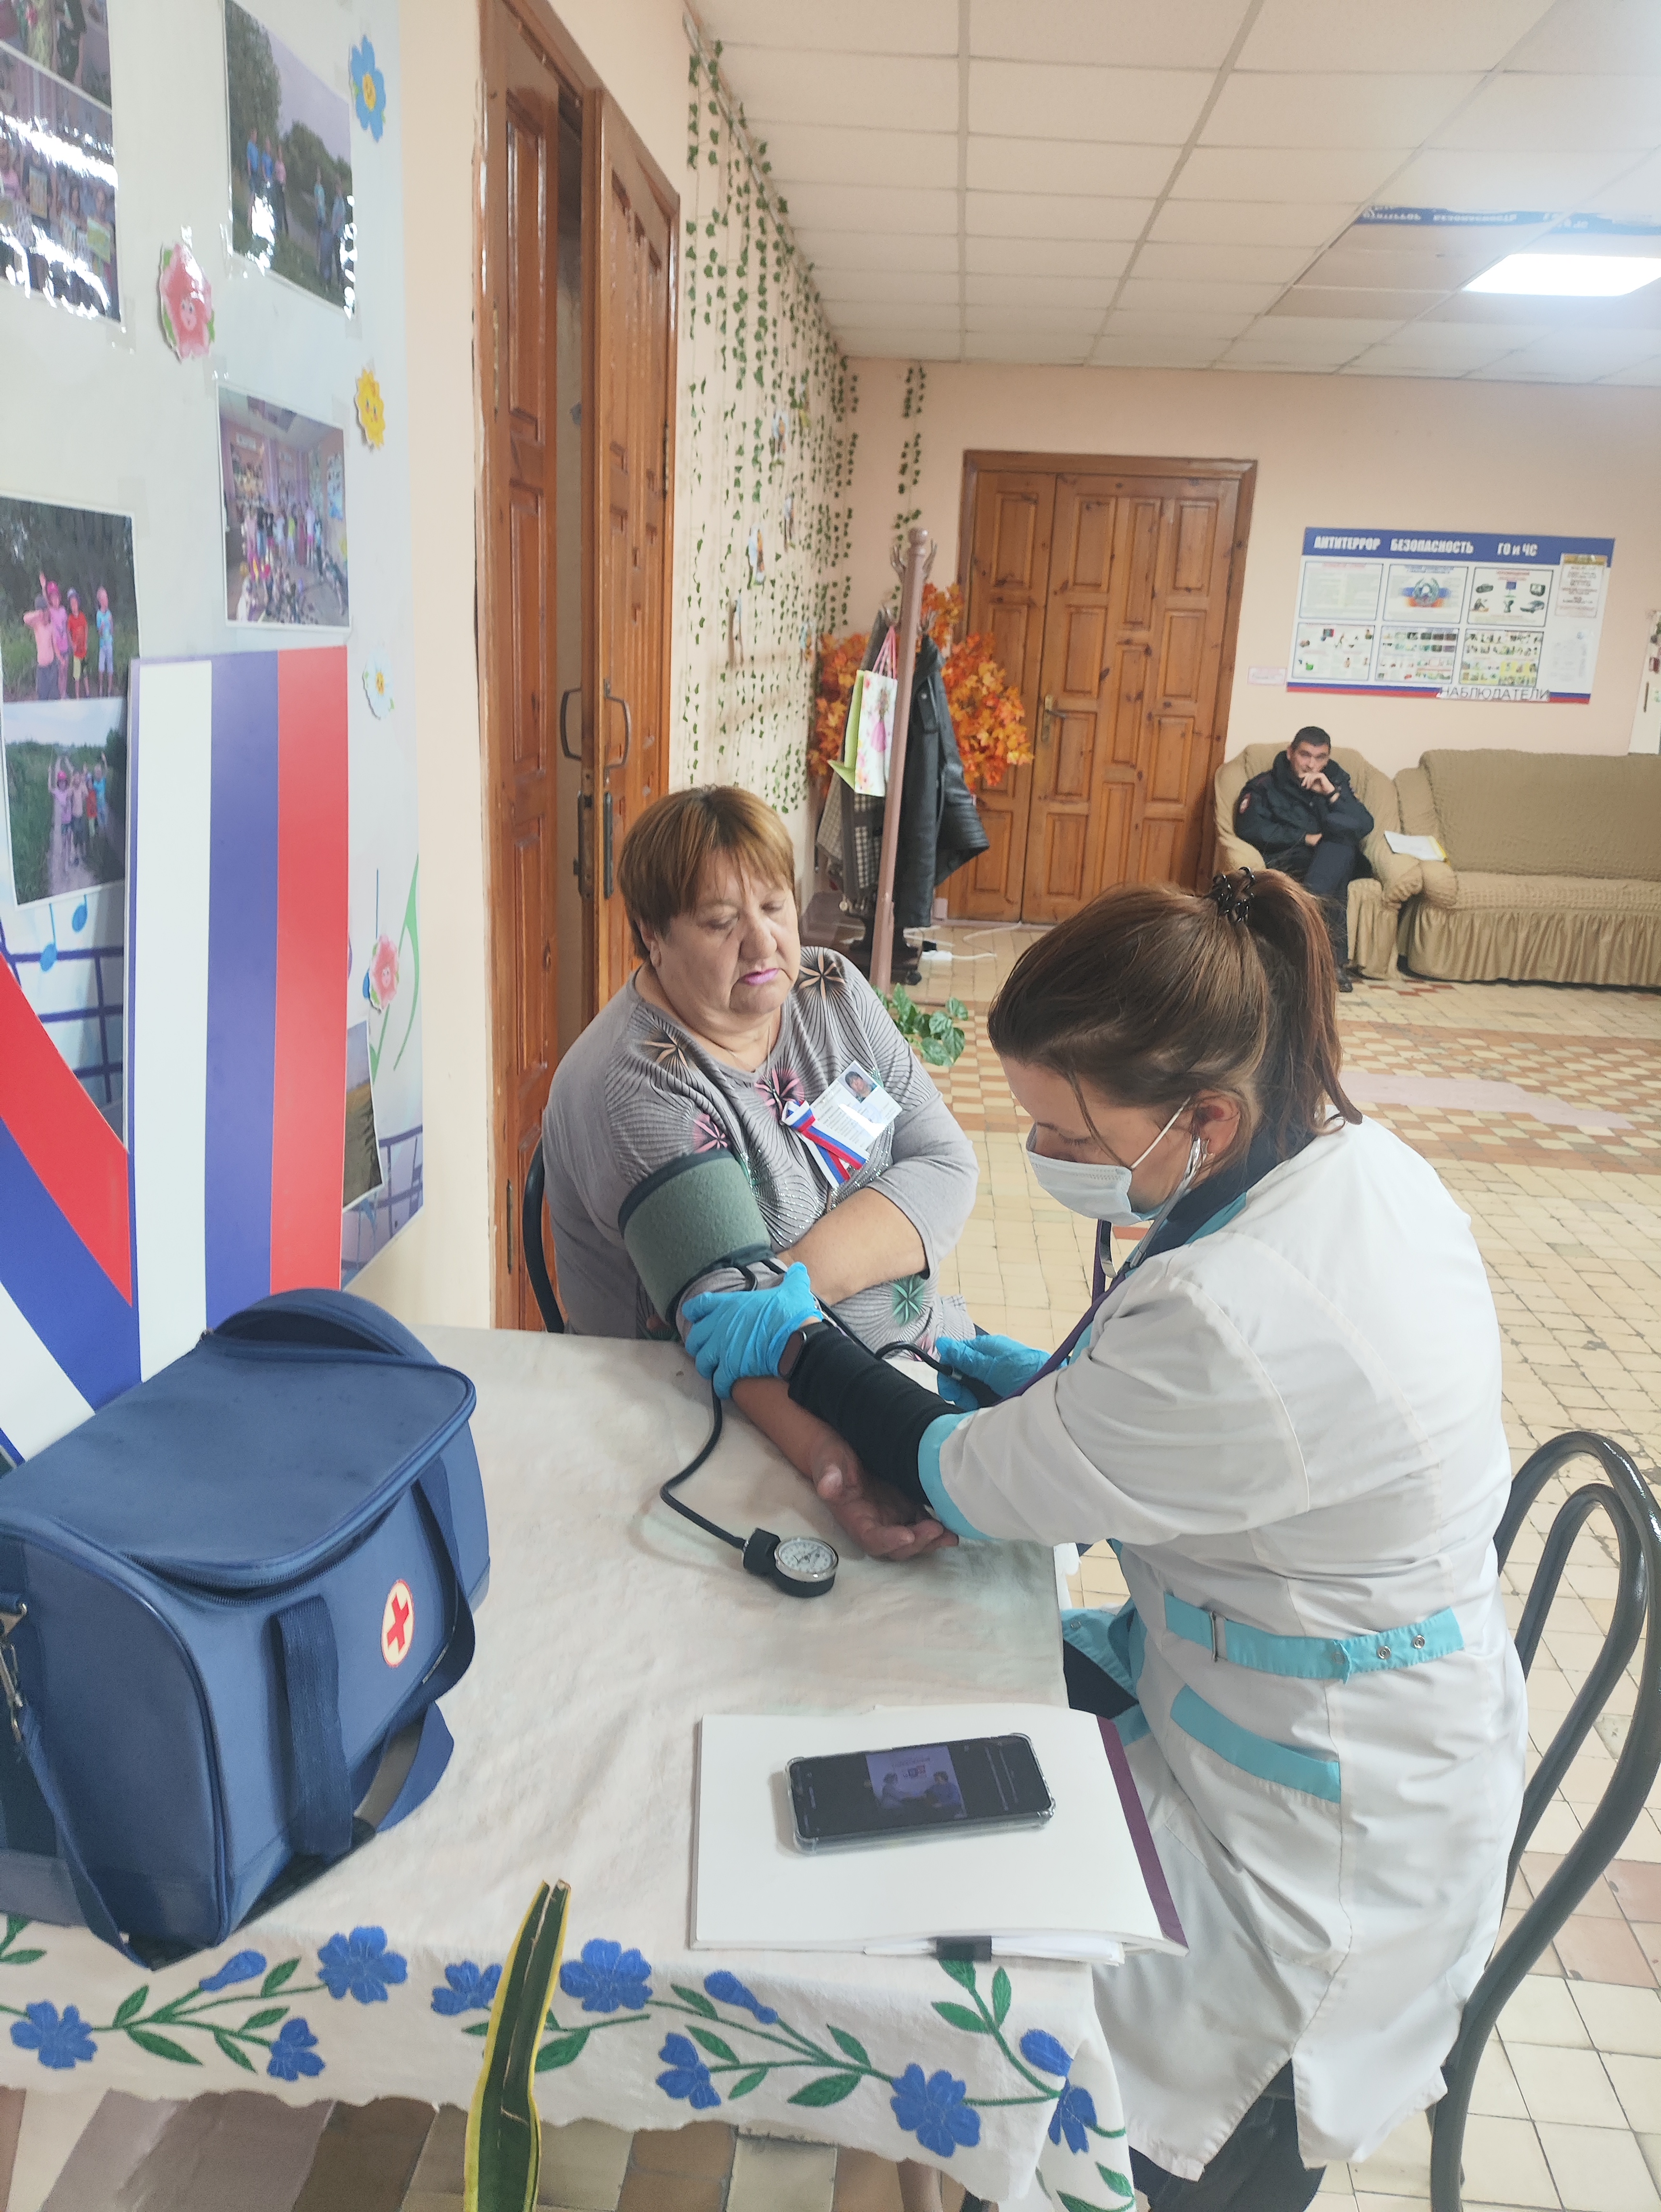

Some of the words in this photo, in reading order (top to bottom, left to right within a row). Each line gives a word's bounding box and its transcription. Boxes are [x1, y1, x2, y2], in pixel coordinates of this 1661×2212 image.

[1313, 535, 1381, 550] АНТИТЕРРОР
[1390, 538, 1474, 554] БЕЗОПАСНОСТЬ
[1496, 542, 1511, 556] ГО
[1522, 542, 1538, 557] ЧС
[1440, 686, 1550, 701] НАБЛЮДАТЕЛИ
